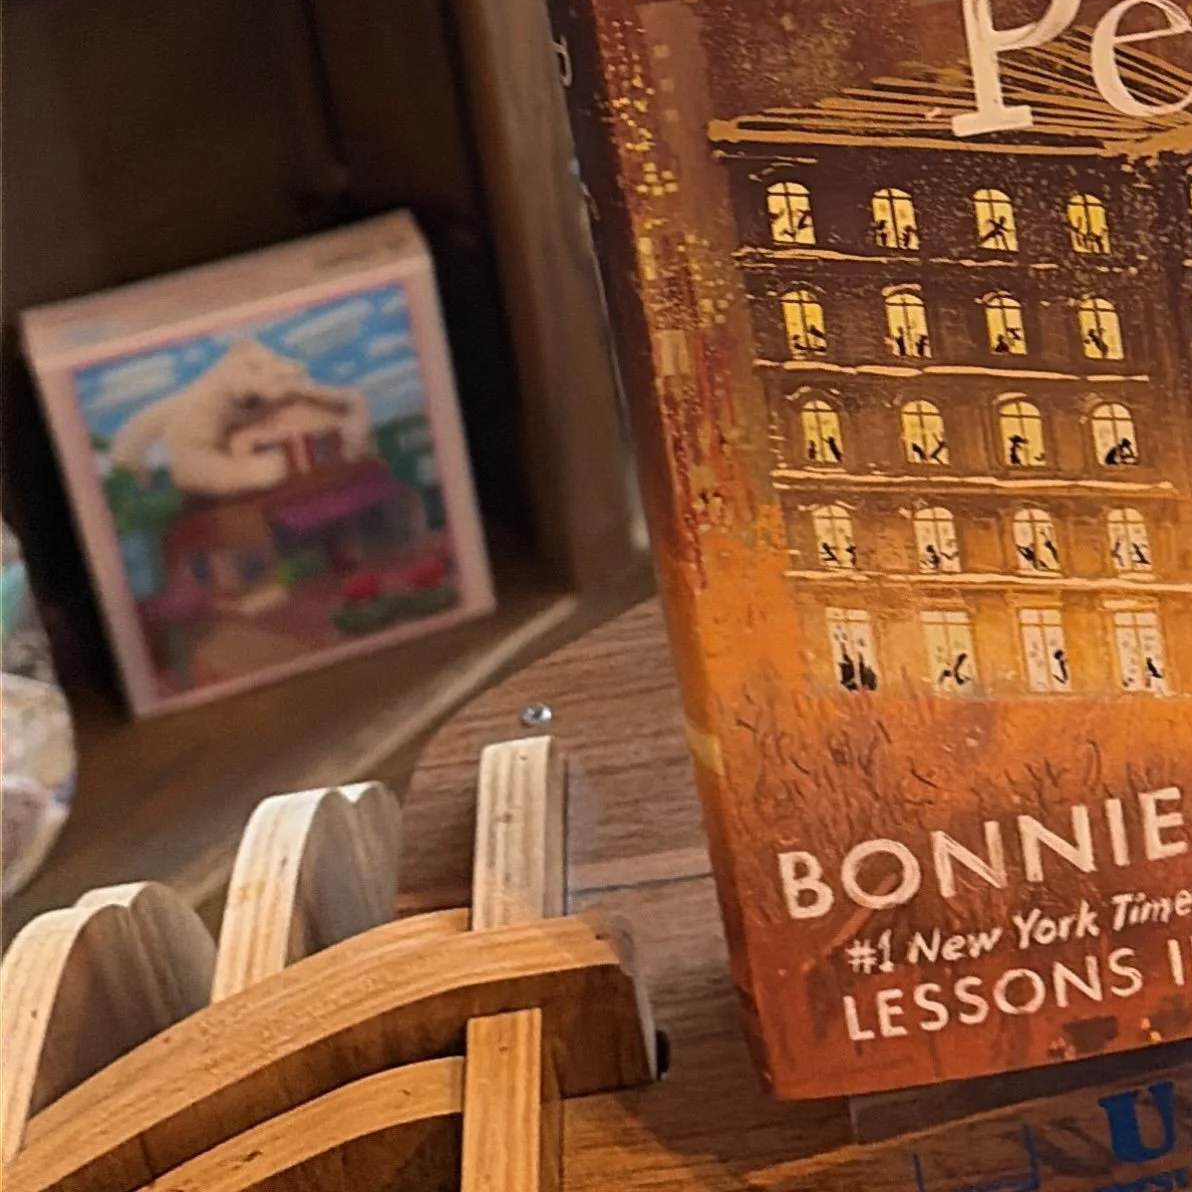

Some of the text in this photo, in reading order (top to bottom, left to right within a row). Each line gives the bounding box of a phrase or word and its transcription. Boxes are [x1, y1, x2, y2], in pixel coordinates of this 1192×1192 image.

[777, 786, 1190, 921] BONNIE
[845, 929, 895, 975] #1
[906, 925, 1004, 966] New
[1012, 902, 1101, 951] York
[842, 948, 1144, 1043] LESSONS
